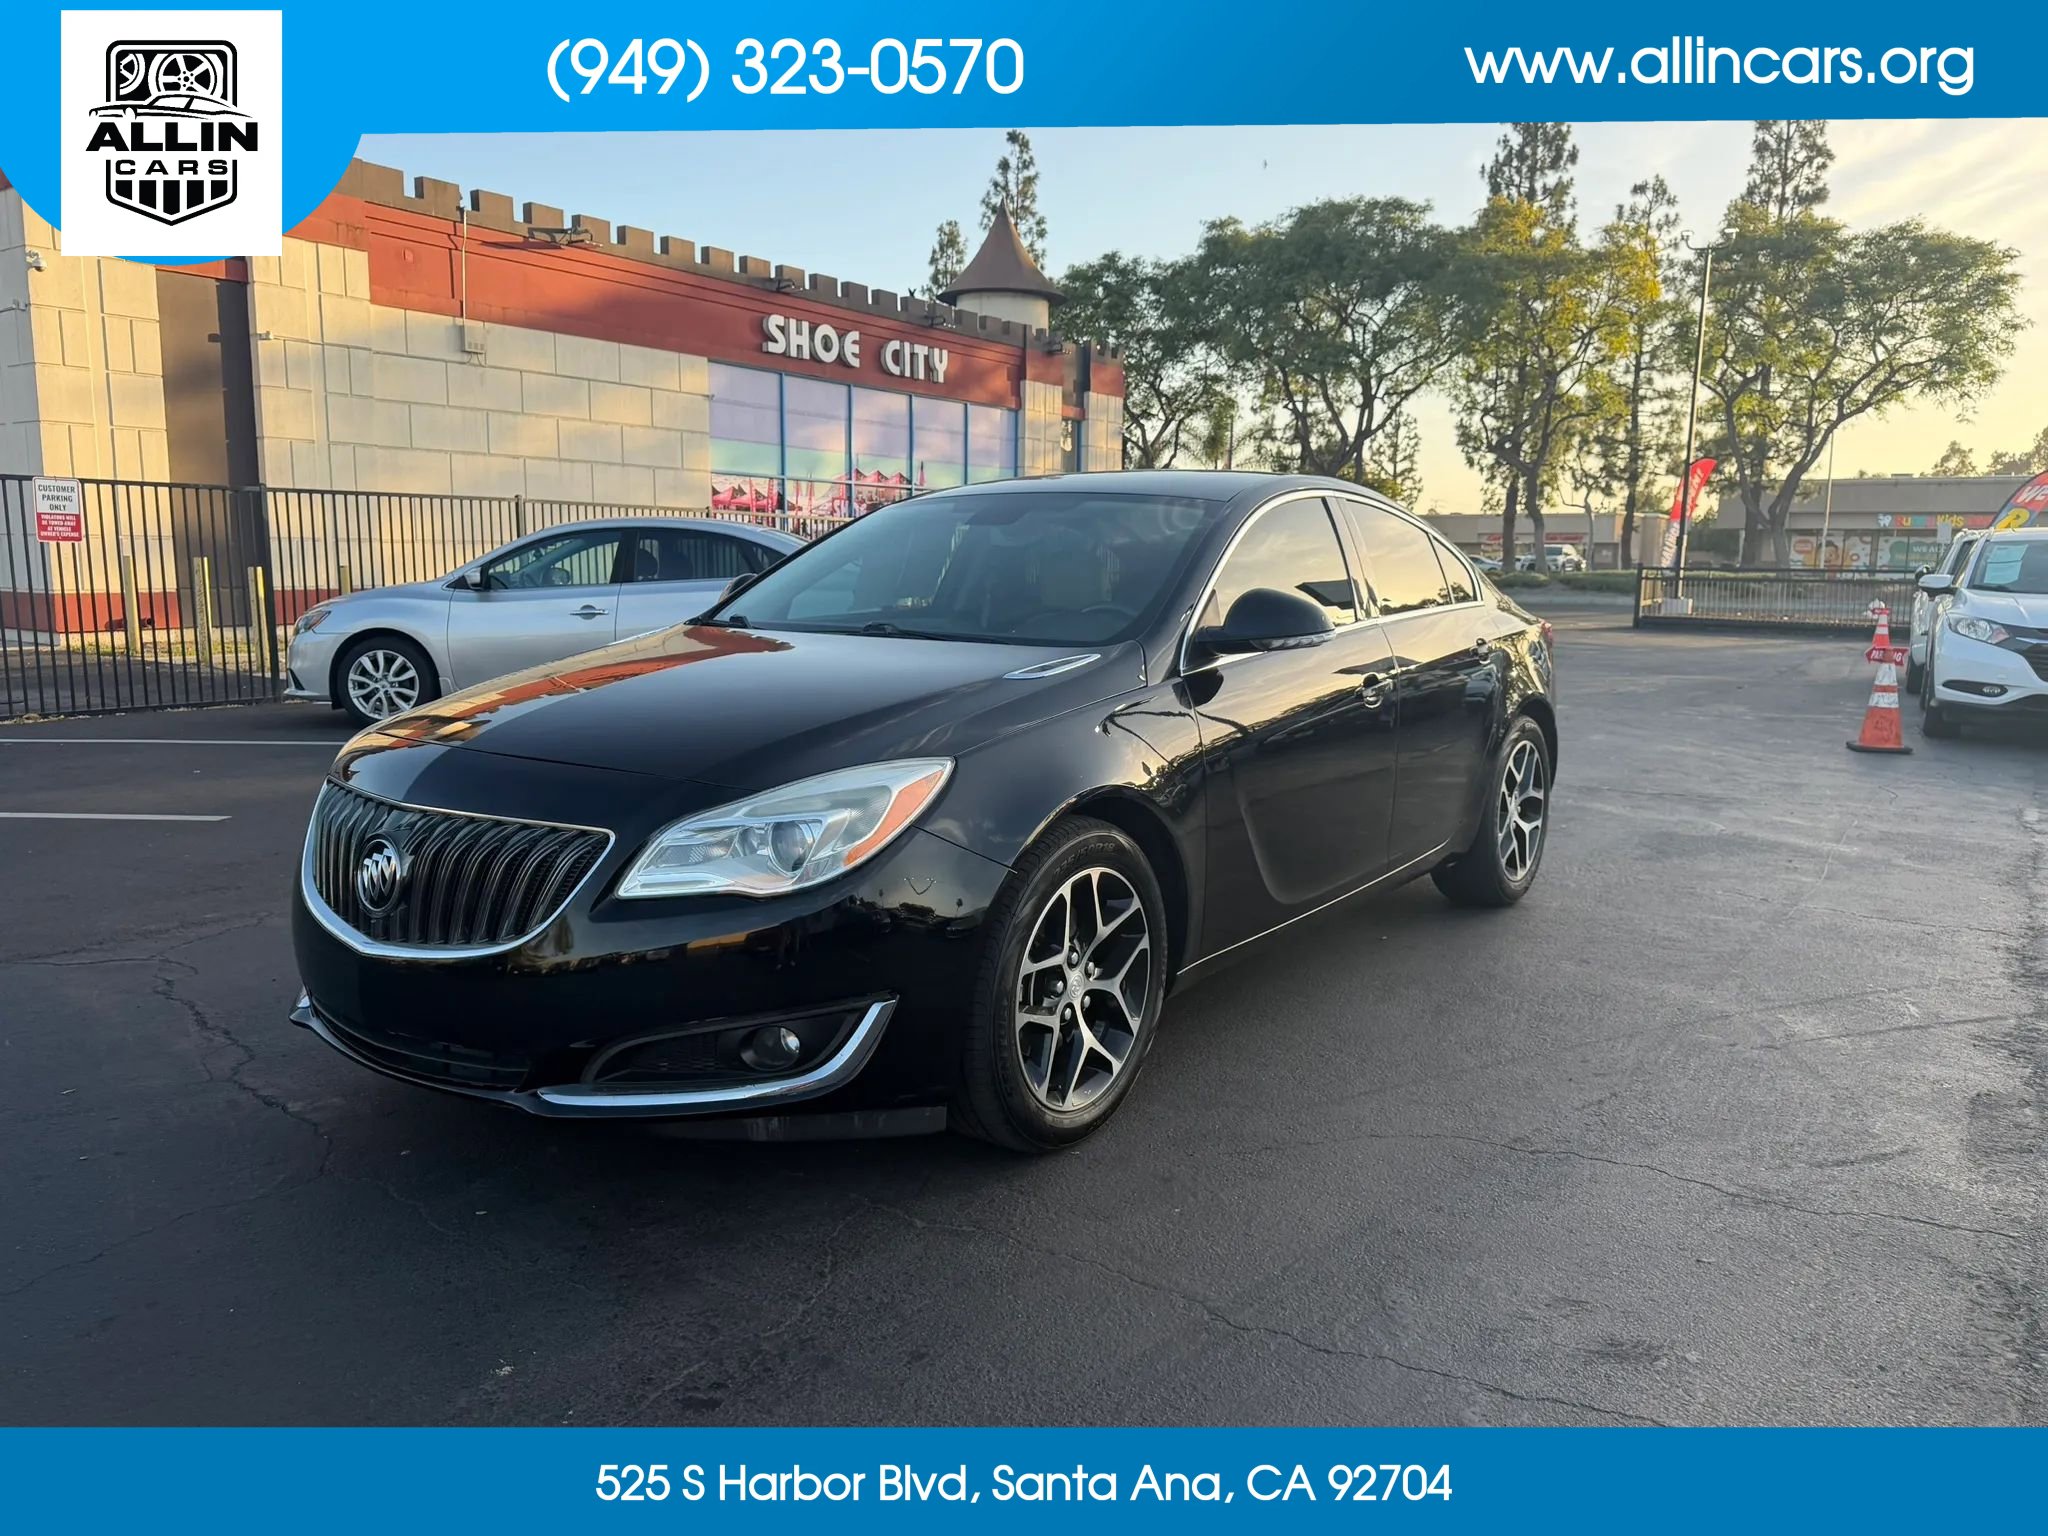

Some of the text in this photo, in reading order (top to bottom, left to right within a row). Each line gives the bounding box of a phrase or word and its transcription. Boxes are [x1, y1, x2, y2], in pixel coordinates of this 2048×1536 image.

[763, 314, 948, 383] SHOE CITY
[38, 484, 76, 493] CUSTOMER
[42, 494, 73, 503] PARKING
[49, 503, 67, 511] ONLY
